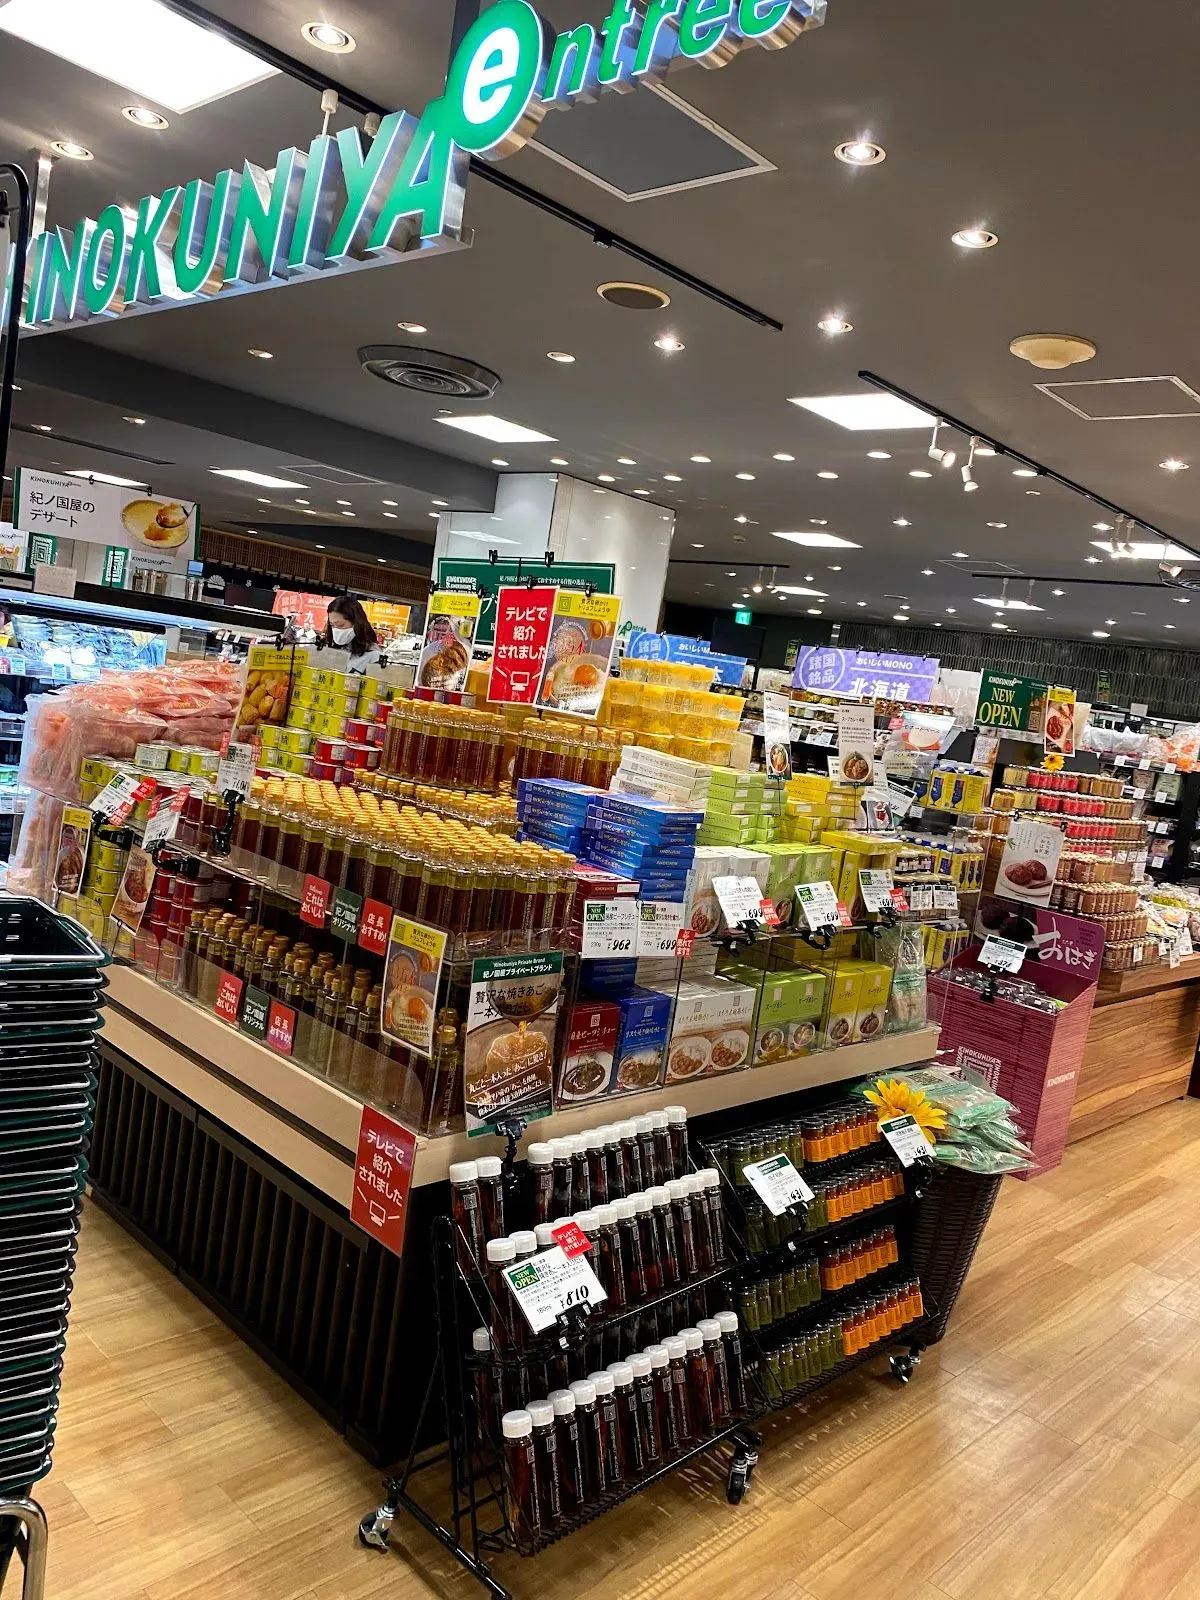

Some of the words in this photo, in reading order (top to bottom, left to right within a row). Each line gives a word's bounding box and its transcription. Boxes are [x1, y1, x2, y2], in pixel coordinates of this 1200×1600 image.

[29, 490, 95, 514] 紀ノ国屋の
[29, 508, 79, 528] デザート
[505, 606, 548, 622] テレビで
[513, 625, 536, 642] 紹介
[809, 652, 835, 670] 諸国
[856, 656, 913, 670] おいしいMONO
[849, 677, 911, 702] 北海道
[991, 687, 1016, 704] NEW
[976, 701, 1022, 728] OPEN
[305, 891, 324, 908] これは
[301, 901, 325, 919] おいしい
[586, 913, 606, 921] OPEN
[332, 917, 356, 934] オリジナル
[1032, 916, 1097, 970] おはぎ
[482, 964, 553, 979] 紀ノ国屋プライベートブランド
[475, 983, 545, 1005] 贅沢な焼きあご
[216, 997, 237, 1014] おいしい
[243, 1014, 265, 1031] オリジナル
[367, 1128, 405, 1165] テレビで
[372, 1152, 393, 1178] 紹介
[359, 1165, 403, 1207] されました
[514, 1274, 540, 1290] OPEN
[516, 1270, 530, 1280] NEW
[560, 1285, 590, 1310] ¥810
